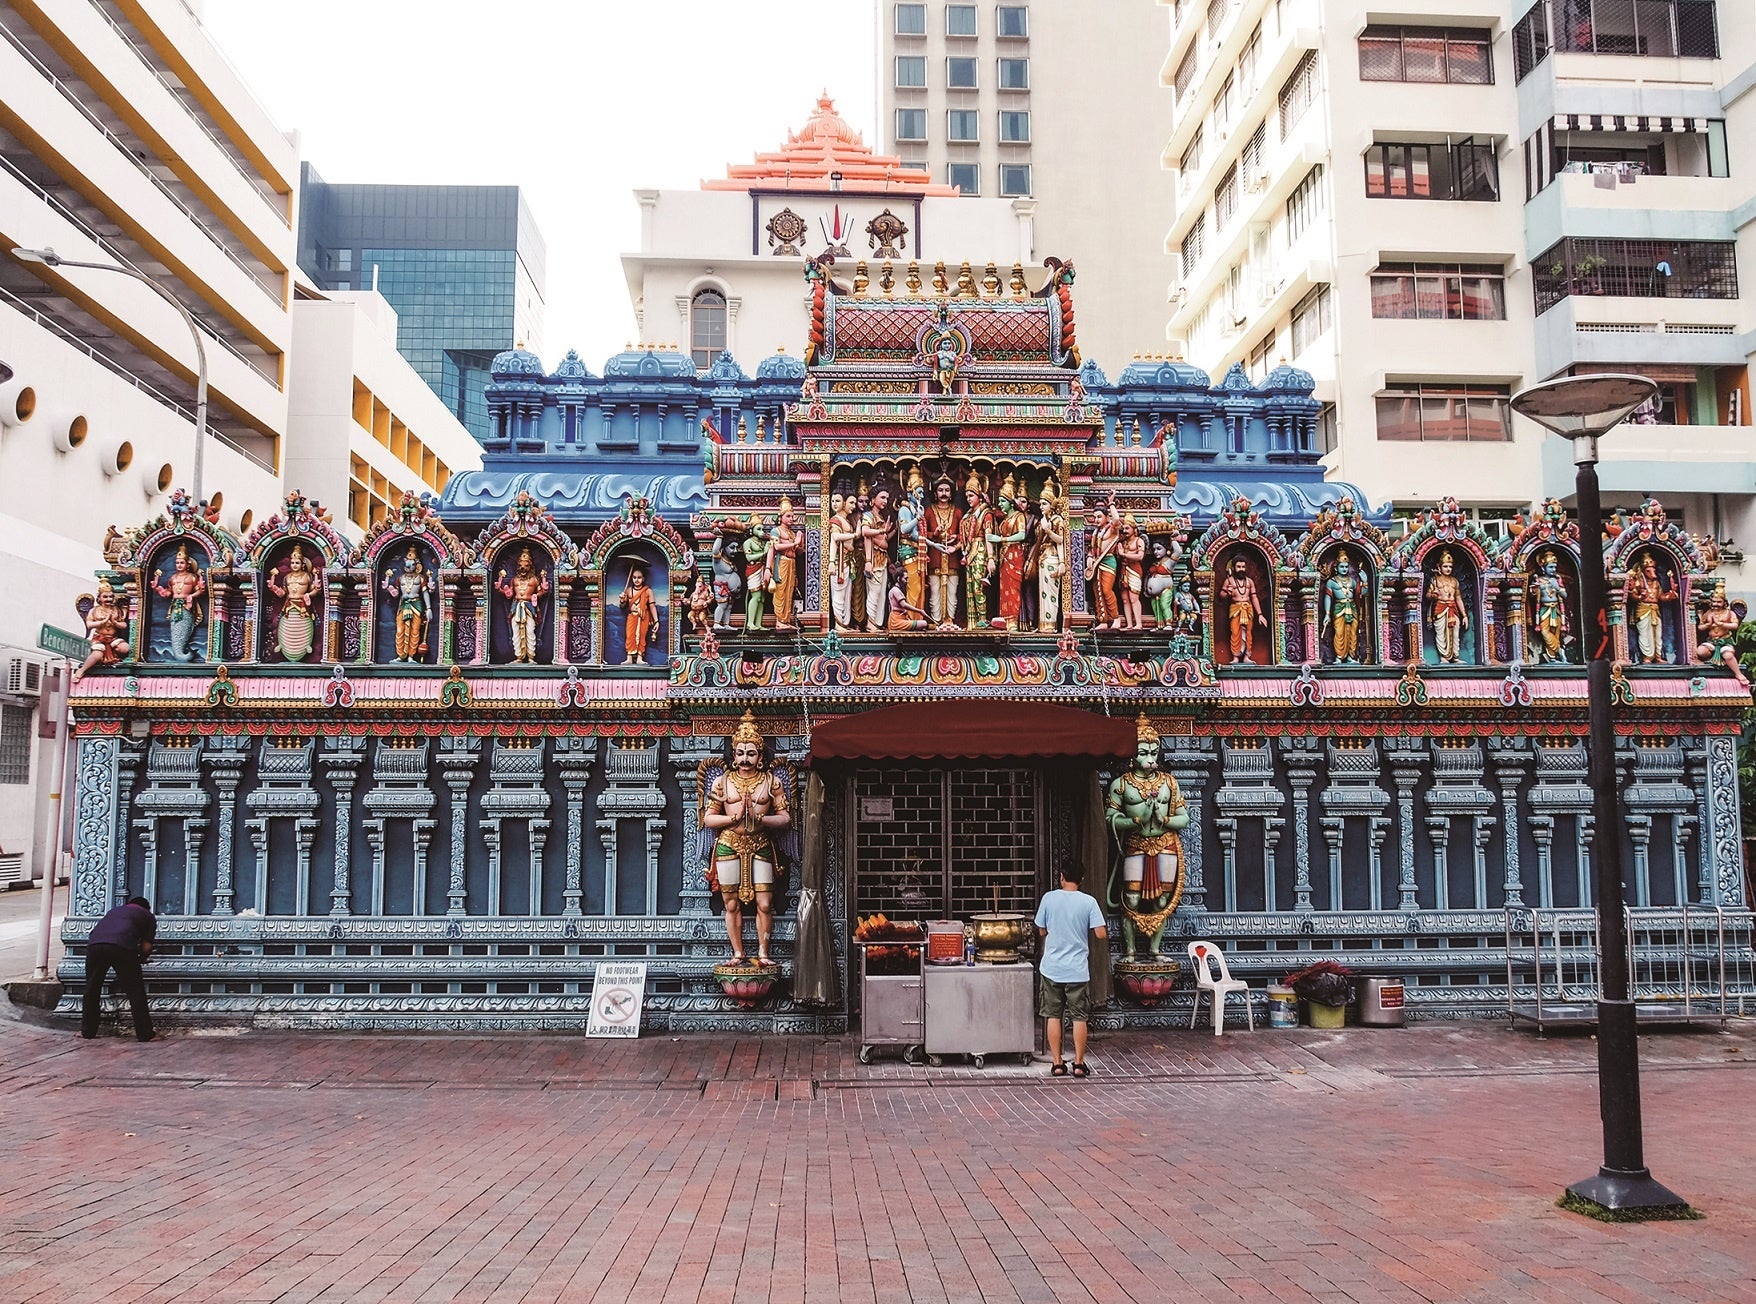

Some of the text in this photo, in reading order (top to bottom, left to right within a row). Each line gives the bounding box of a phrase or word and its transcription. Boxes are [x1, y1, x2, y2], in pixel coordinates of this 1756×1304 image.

[43, 628, 80, 656] Bencoolen
[606, 967, 639, 975] NO FOOTWEAR
[599, 977, 643, 985] BEYOND THIS POINT
